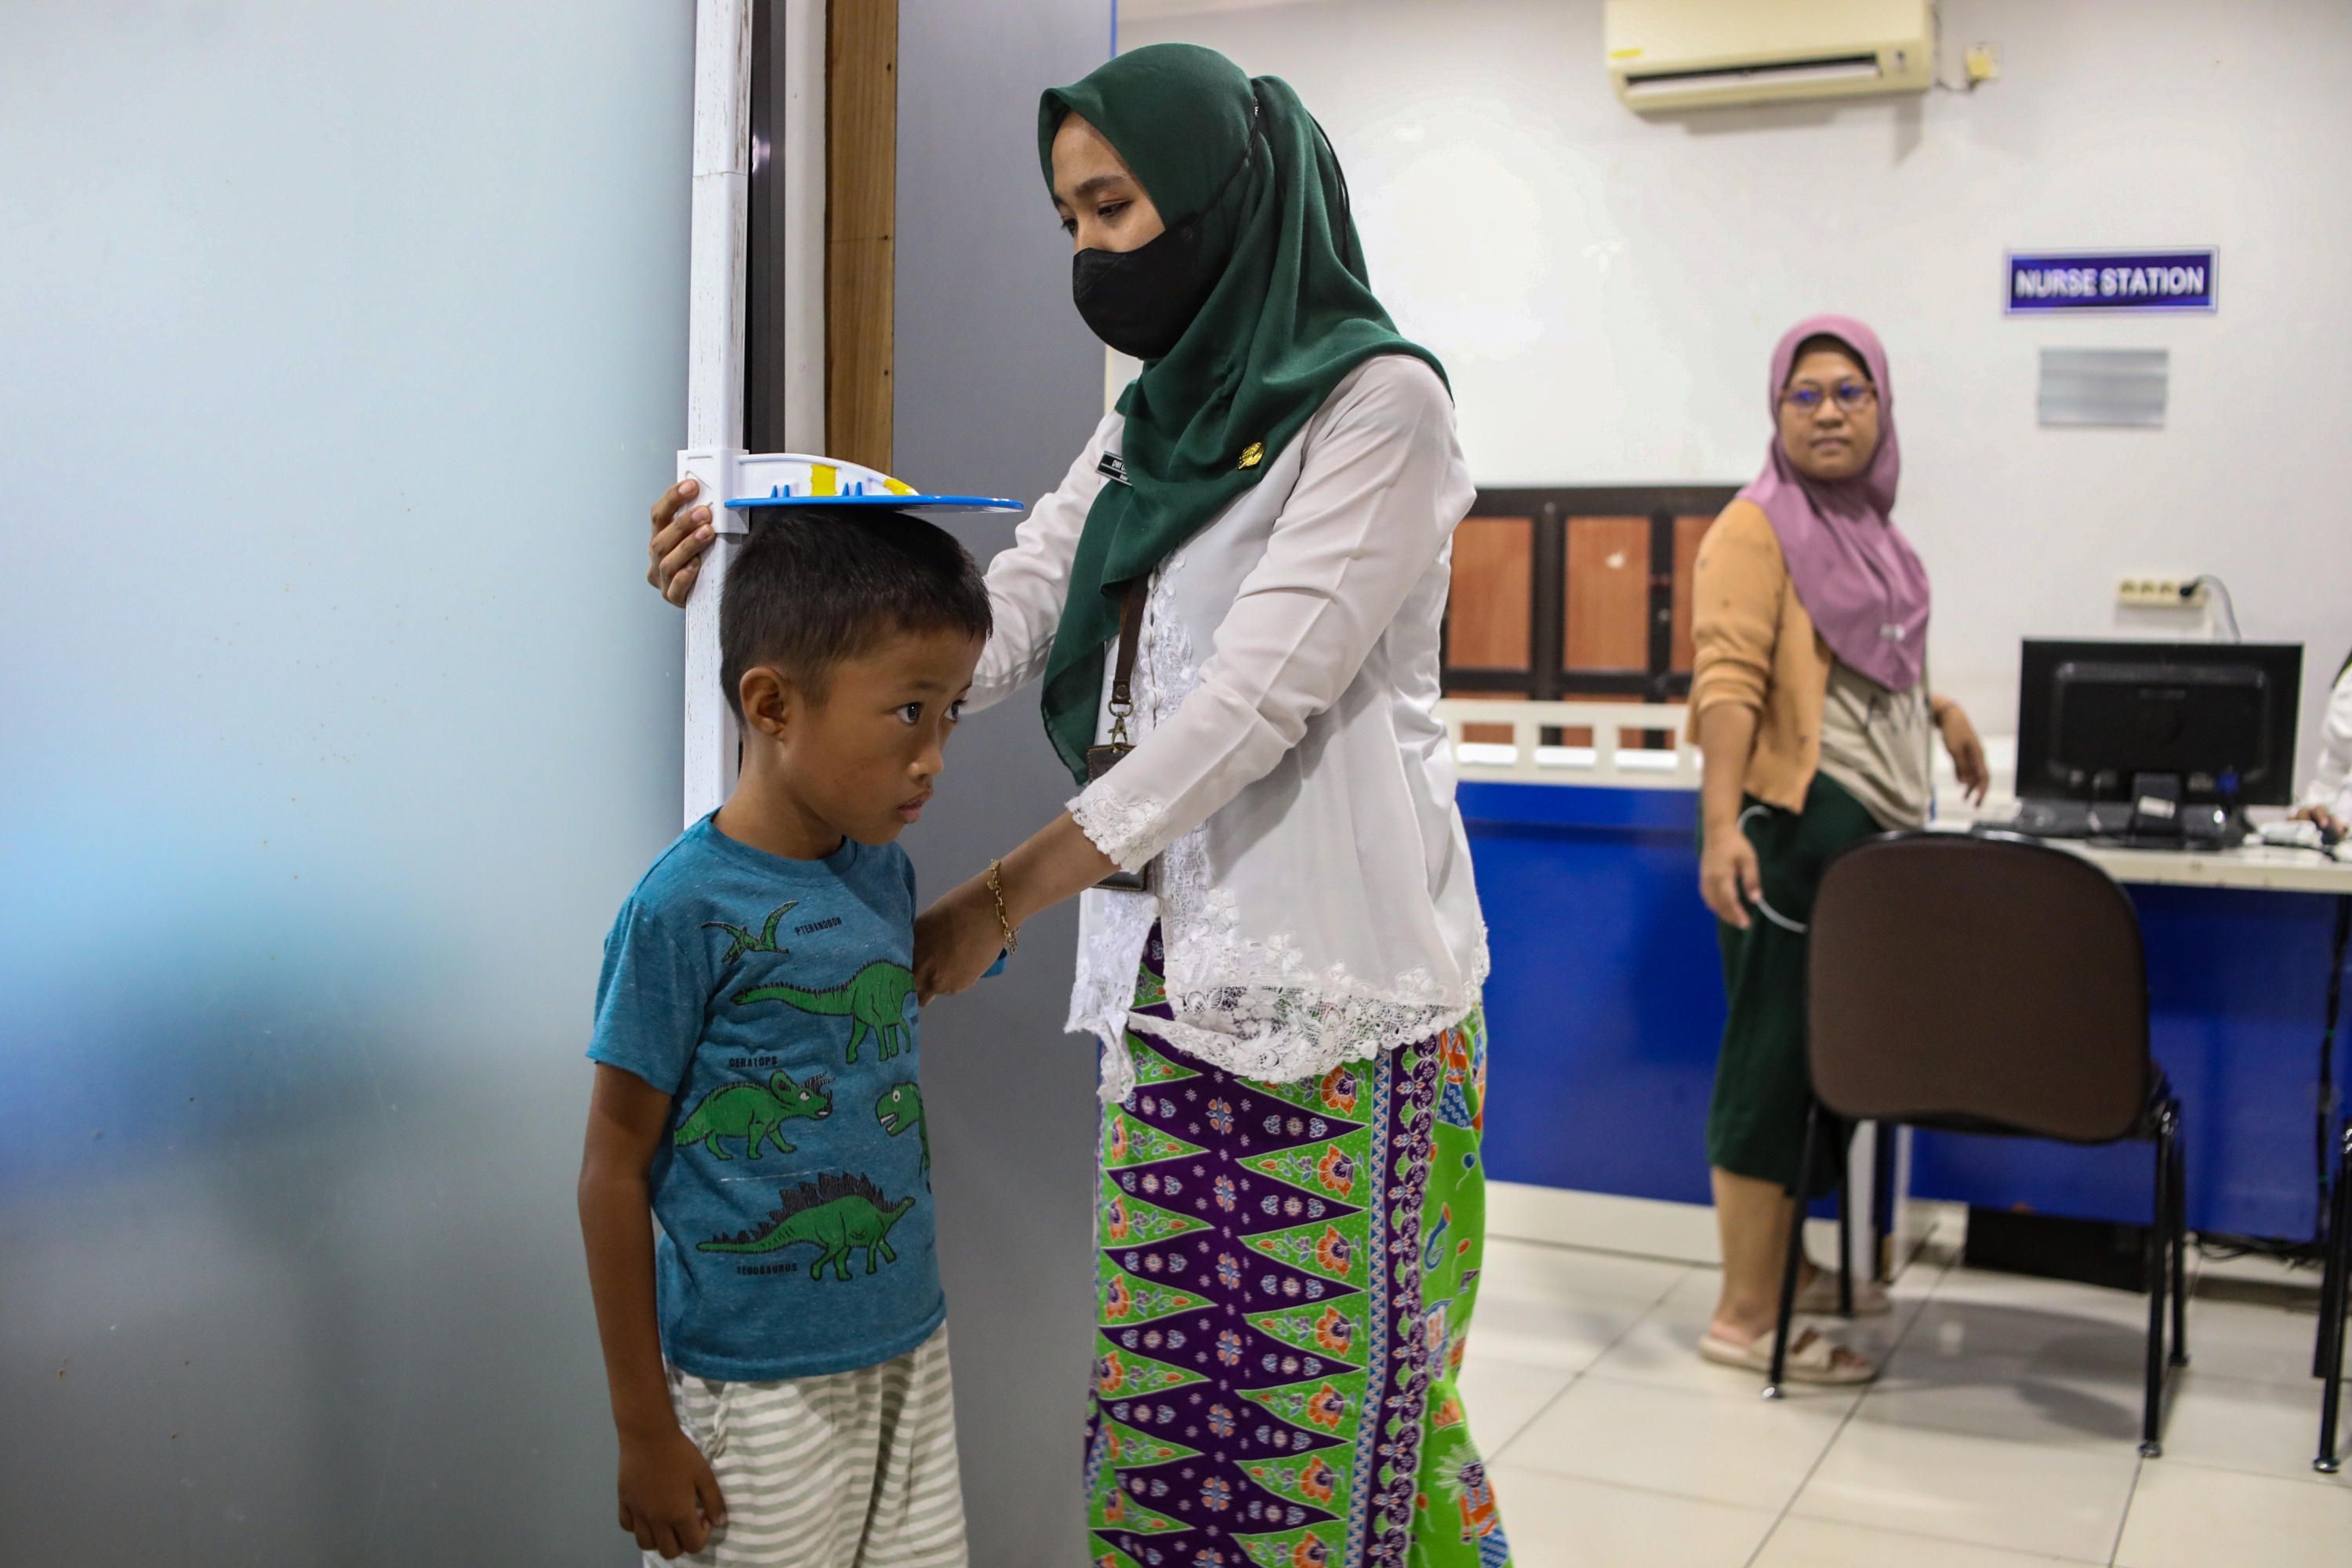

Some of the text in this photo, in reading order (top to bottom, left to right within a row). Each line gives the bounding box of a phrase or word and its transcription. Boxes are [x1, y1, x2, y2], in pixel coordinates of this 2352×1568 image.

[2015, 266, 2205, 298] NURSE STATION
[794, 916, 843, 937] PTERANODON
[728, 1055, 779, 1068] CERATOPS
